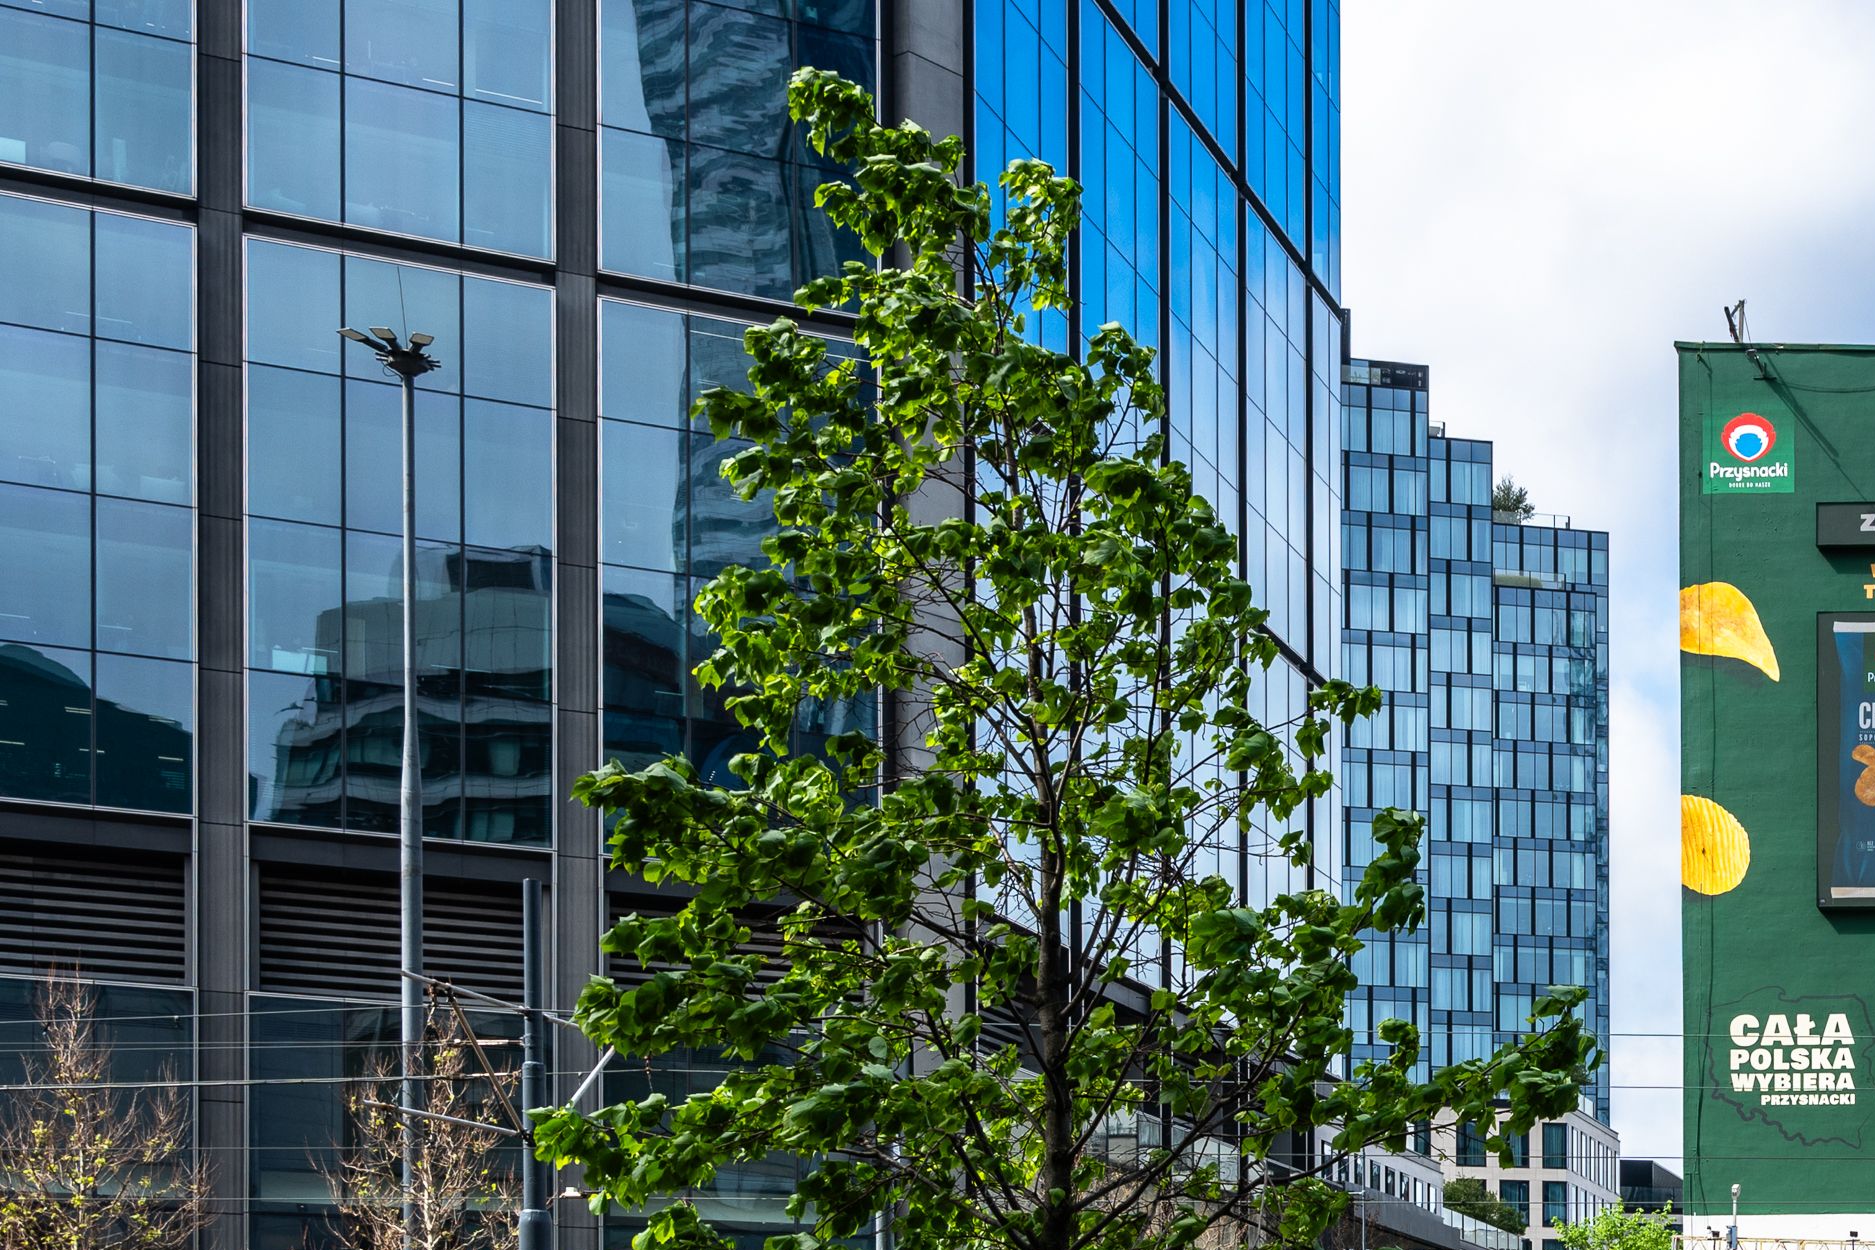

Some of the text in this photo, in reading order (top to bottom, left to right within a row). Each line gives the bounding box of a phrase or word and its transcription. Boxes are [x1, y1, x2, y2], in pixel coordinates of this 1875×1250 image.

[1710, 462, 1788, 481] Przysnacki
[1729, 1013, 1855, 1047] CAŁA
[1730, 1047, 1855, 1071] POLSKA
[1730, 1072, 1855, 1092] WYBIERA
[1760, 1093, 1855, 1106] PRZYSNACKI
